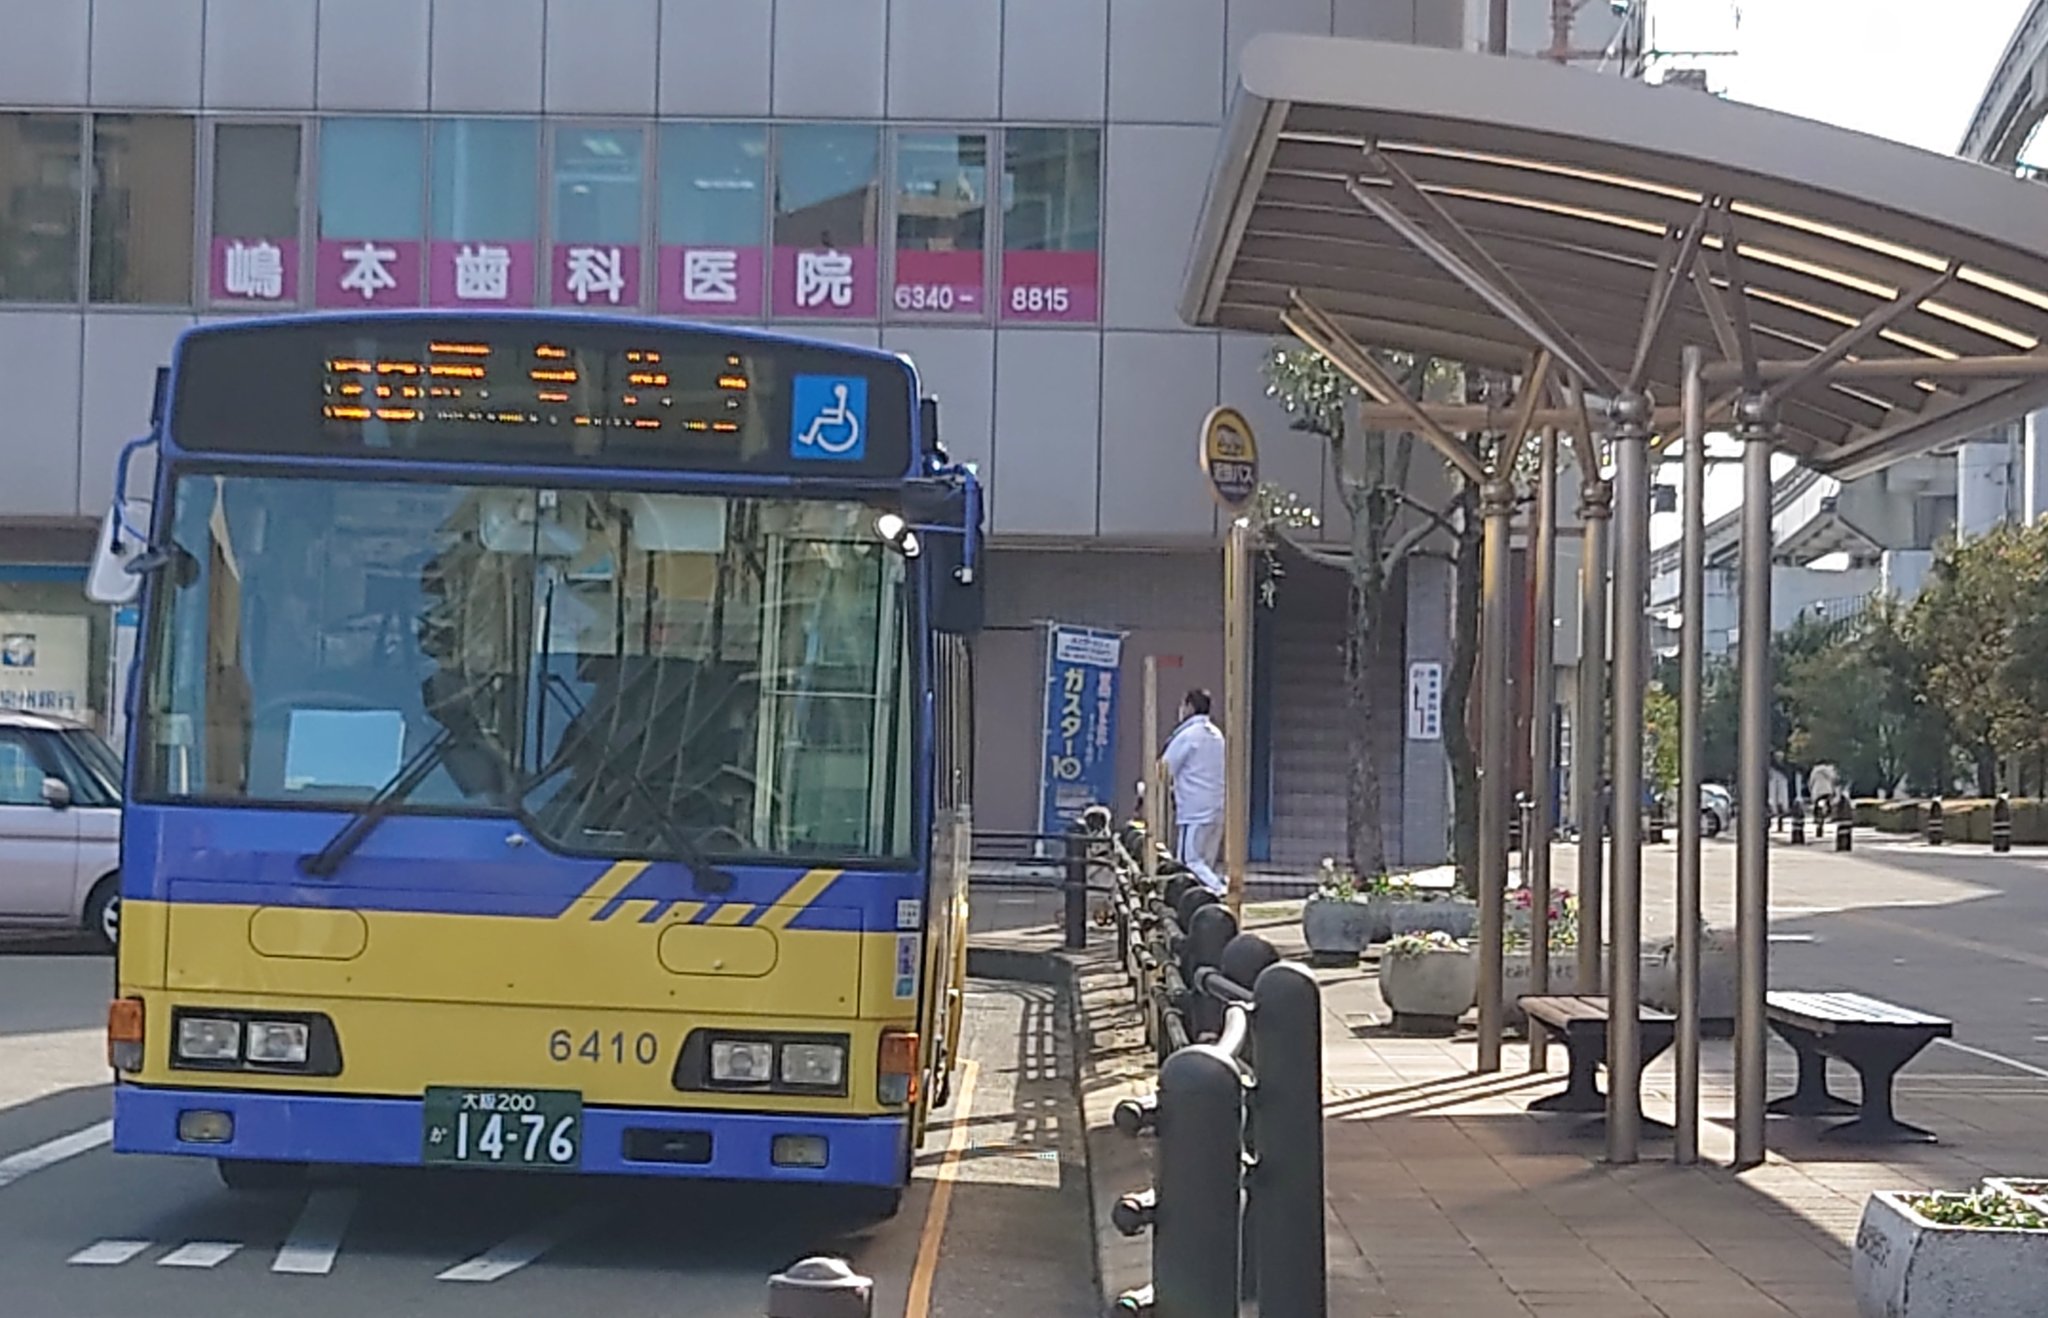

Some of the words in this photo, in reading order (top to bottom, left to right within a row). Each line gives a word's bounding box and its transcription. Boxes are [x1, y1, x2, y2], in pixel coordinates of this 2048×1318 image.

[1012, 287, 1069, 312] 8815
[550, 1029, 658, 1065] 6410
[457, 1112, 575, 1162] 14-76
